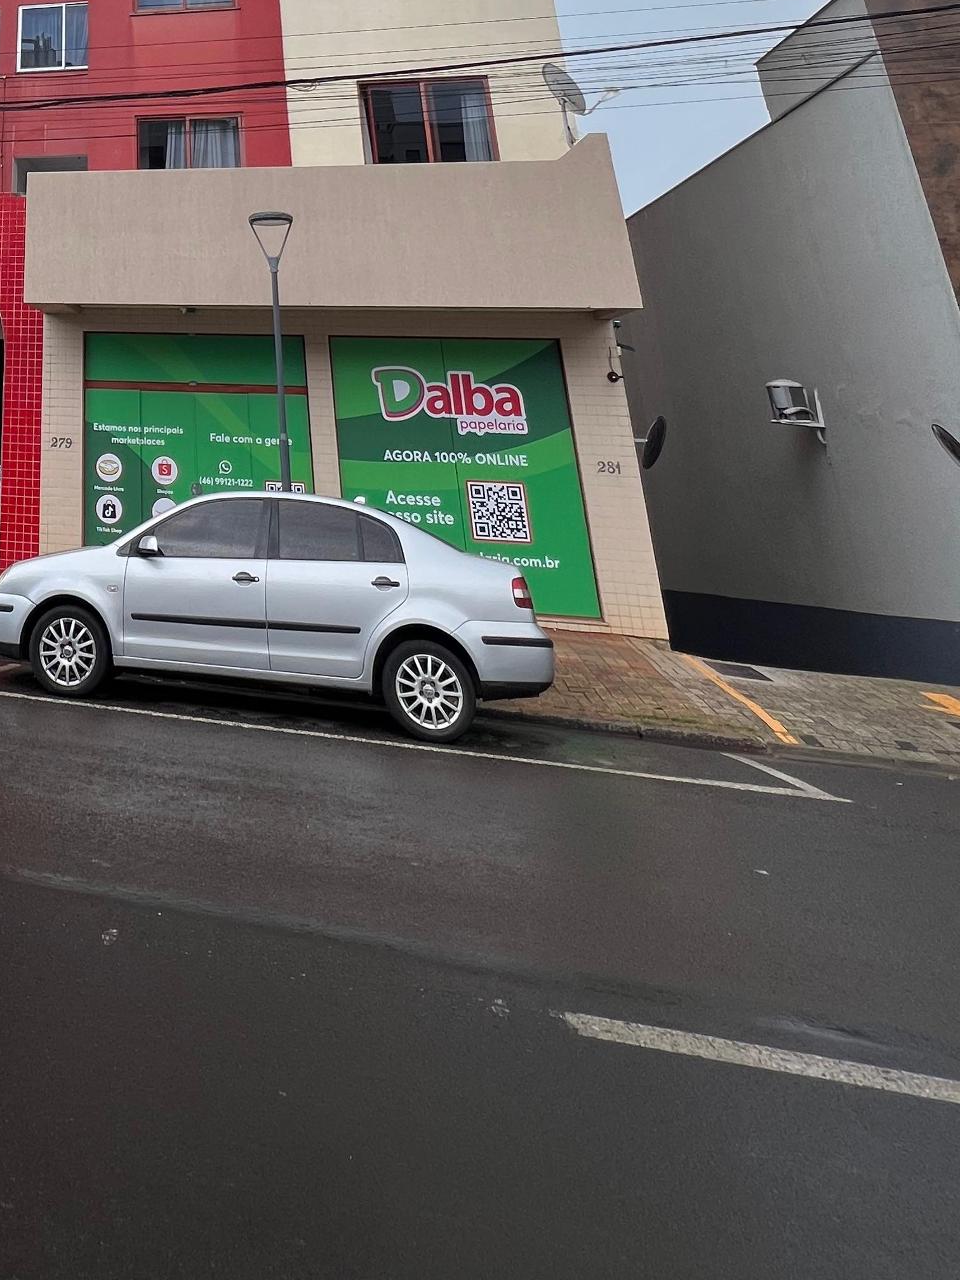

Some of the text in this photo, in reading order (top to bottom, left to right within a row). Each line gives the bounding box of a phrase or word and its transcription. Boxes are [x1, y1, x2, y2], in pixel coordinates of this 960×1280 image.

[373, 367, 524, 419] Dalba
[93, 422, 127, 432] Estamos
[143, 425, 184, 436] principais
[459, 419, 525, 432] papelaria
[51, 436, 73, 449] 279
[111, 436, 165, 446] marketplaces
[209, 432, 231, 443] Fale
[232, 436, 253, 444] com
[255, 437, 262, 445] a
[384, 450, 529, 467] AGORA 100% ONLINE
[597, 460, 621, 475] 281
[199, 476, 253, 487] (46) 99121-1222
[385, 490, 441, 507] Acesse
[425, 509, 454, 525] site
